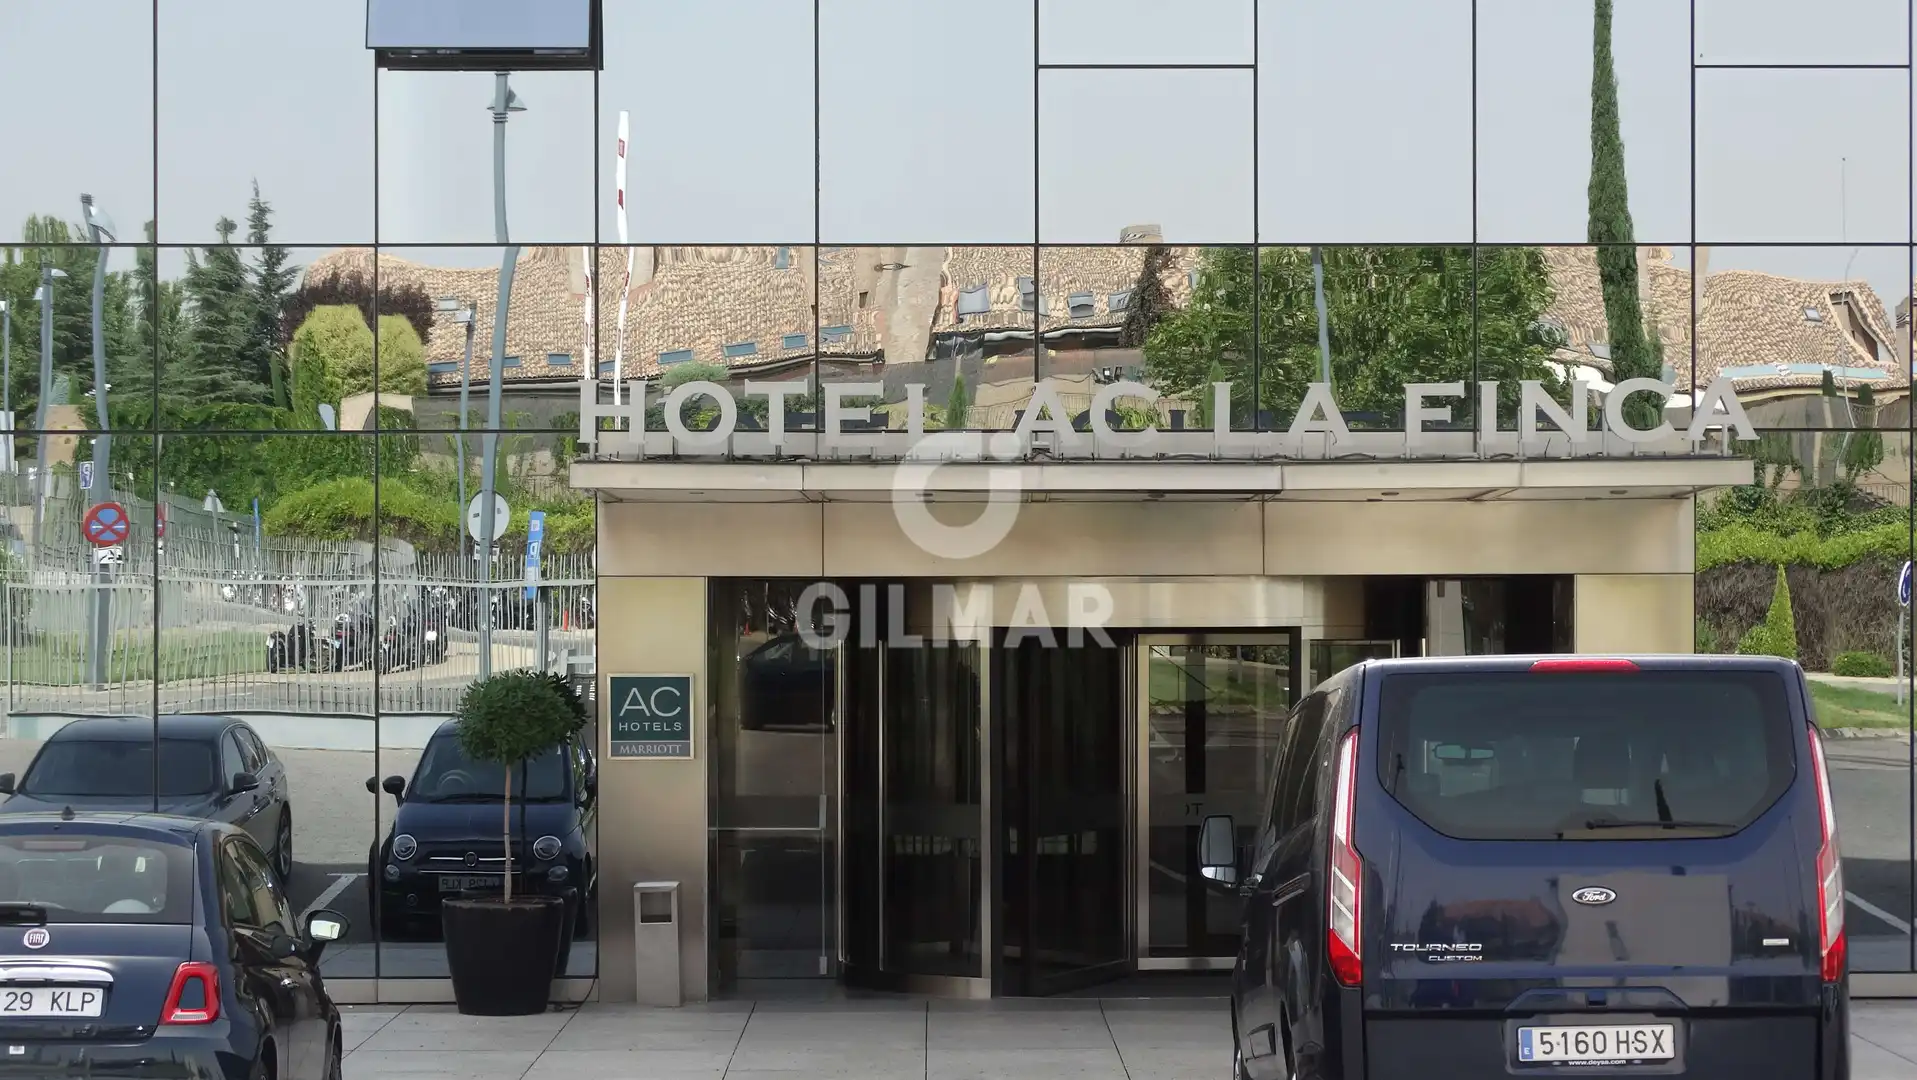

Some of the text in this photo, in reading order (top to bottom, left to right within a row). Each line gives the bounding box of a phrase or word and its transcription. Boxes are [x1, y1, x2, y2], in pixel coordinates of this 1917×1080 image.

[577, 378, 1760, 447] HOTEL AC LA FINCA
[619, 686, 681, 717] AC
[619, 721, 682, 731] HOTELS
[620, 744, 682, 754] MARRIOTT
[1582, 890, 1607, 902] Ford
[29, 933, 46, 944] FIAT
[1390, 943, 1483, 952] TOURNEO
[50, 991, 95, 1012] KLP
[1540, 1031, 1607, 1056] 5160
[1616, 1029, 1666, 1054] HSX
